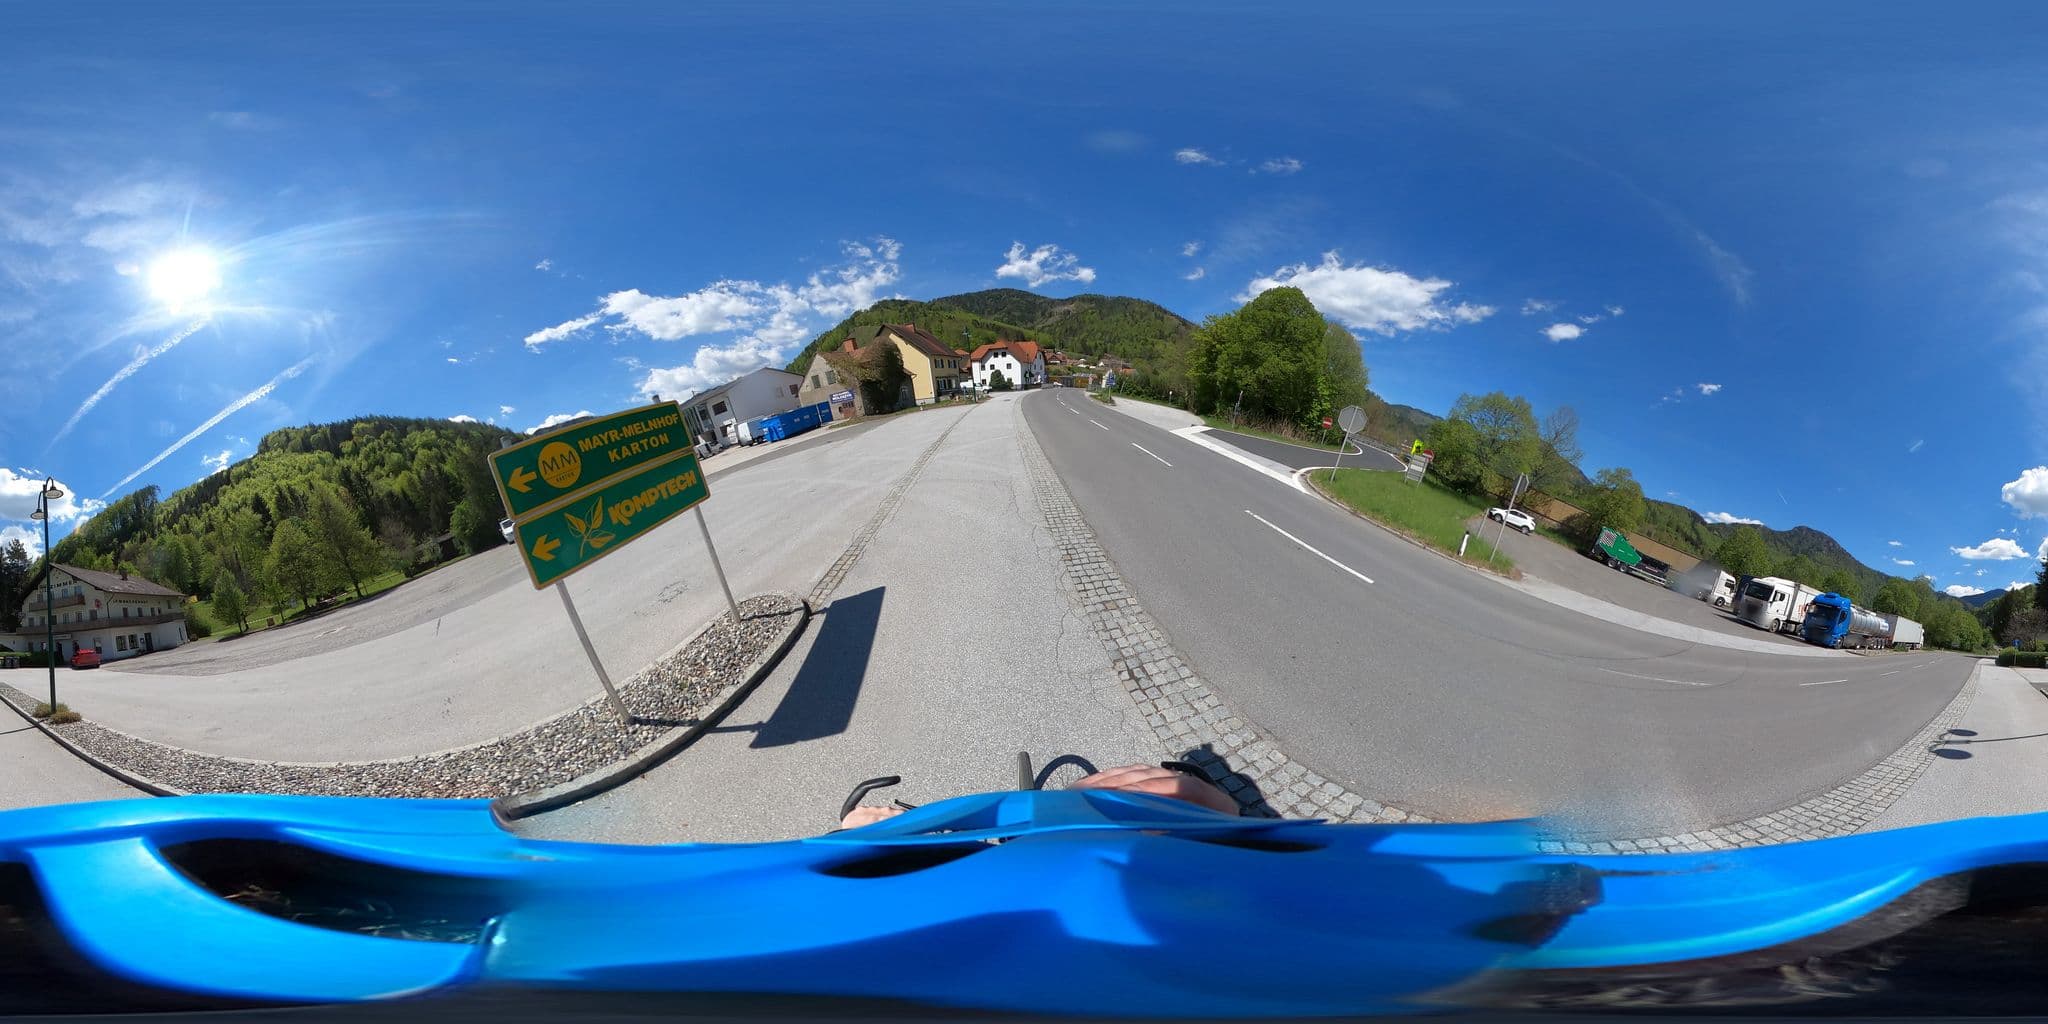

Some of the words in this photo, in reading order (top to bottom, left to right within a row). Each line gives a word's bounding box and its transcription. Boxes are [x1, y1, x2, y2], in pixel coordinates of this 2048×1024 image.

[578, 412, 679, 453] MAYR-MELNHOF
[608, 432, 670, 463] KARTON
[541, 450, 577, 475] MM
[608, 470, 697, 526] KOMPTECH
